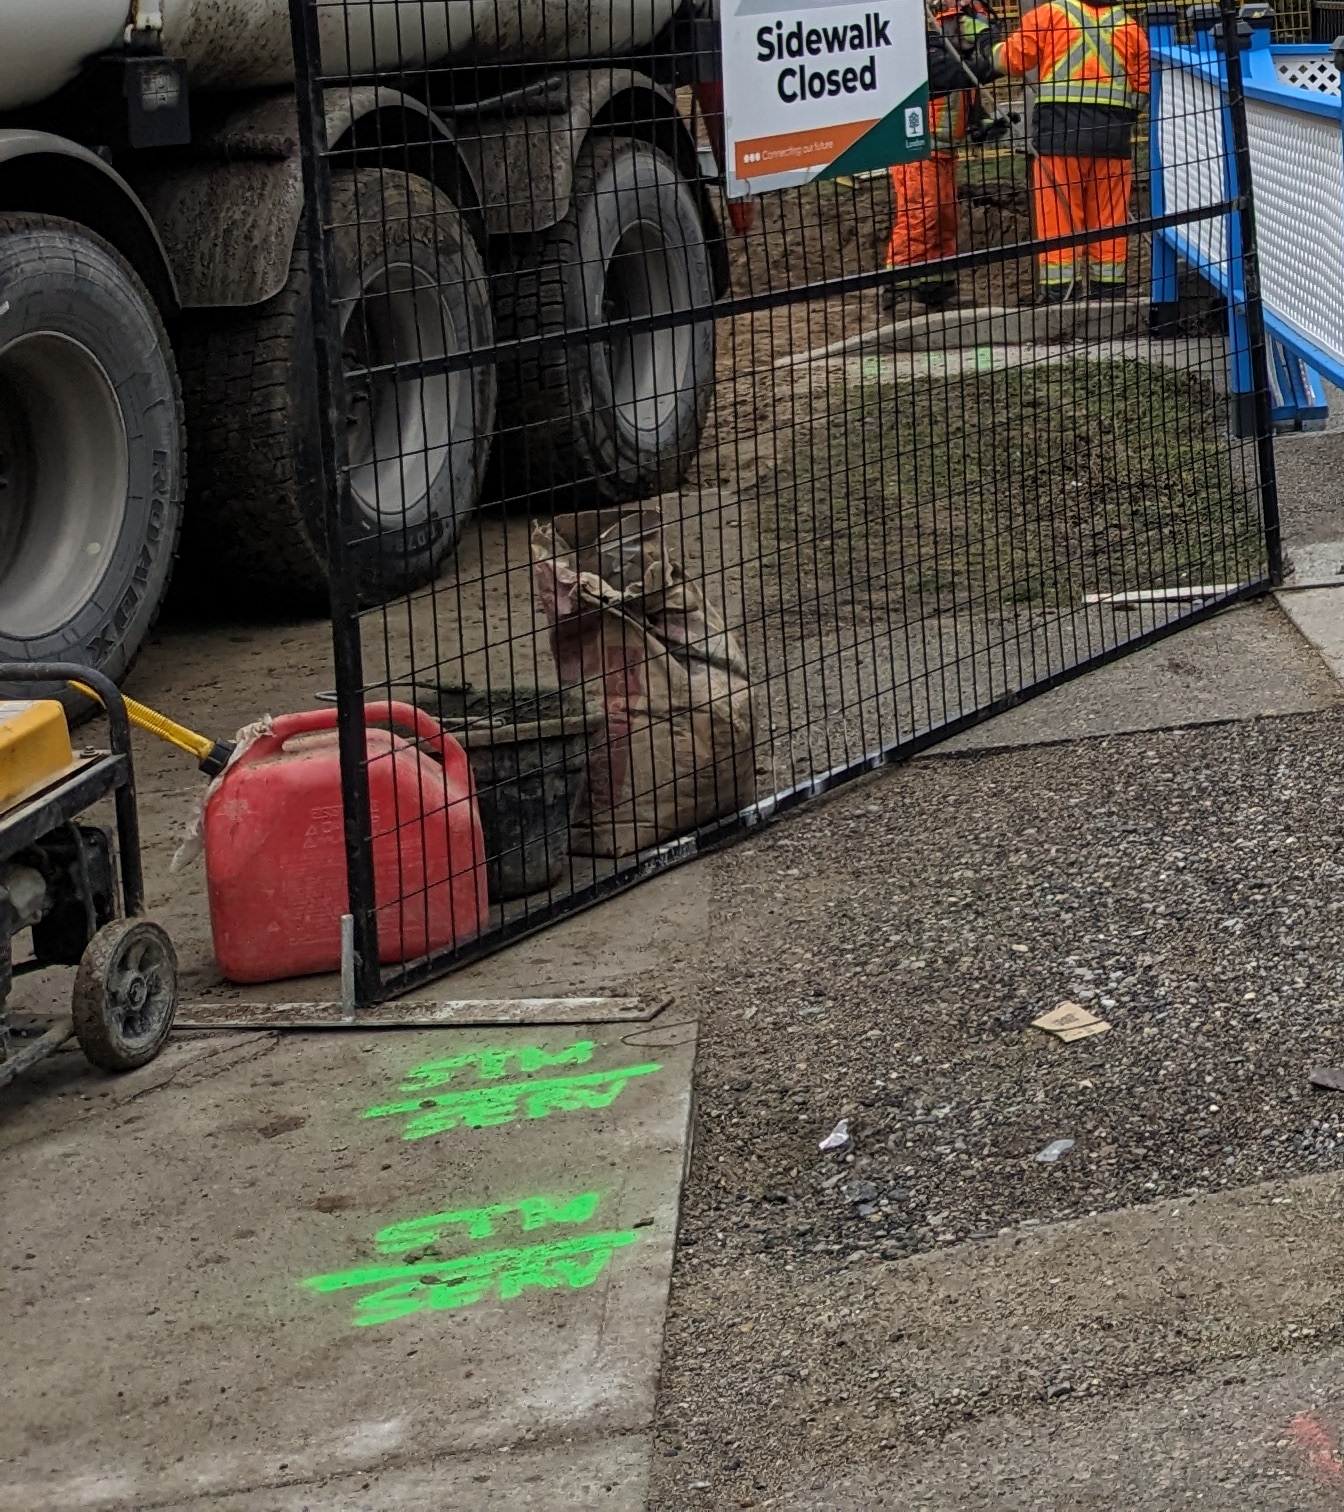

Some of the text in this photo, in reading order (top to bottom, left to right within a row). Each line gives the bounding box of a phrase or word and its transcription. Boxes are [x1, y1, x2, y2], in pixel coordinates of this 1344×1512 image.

[755, 11, 893, 64] Sidewalk
[776, 55, 877, 105] Closed
[761, 144, 801, 161] Connecting
[814, 140, 834, 154] future
